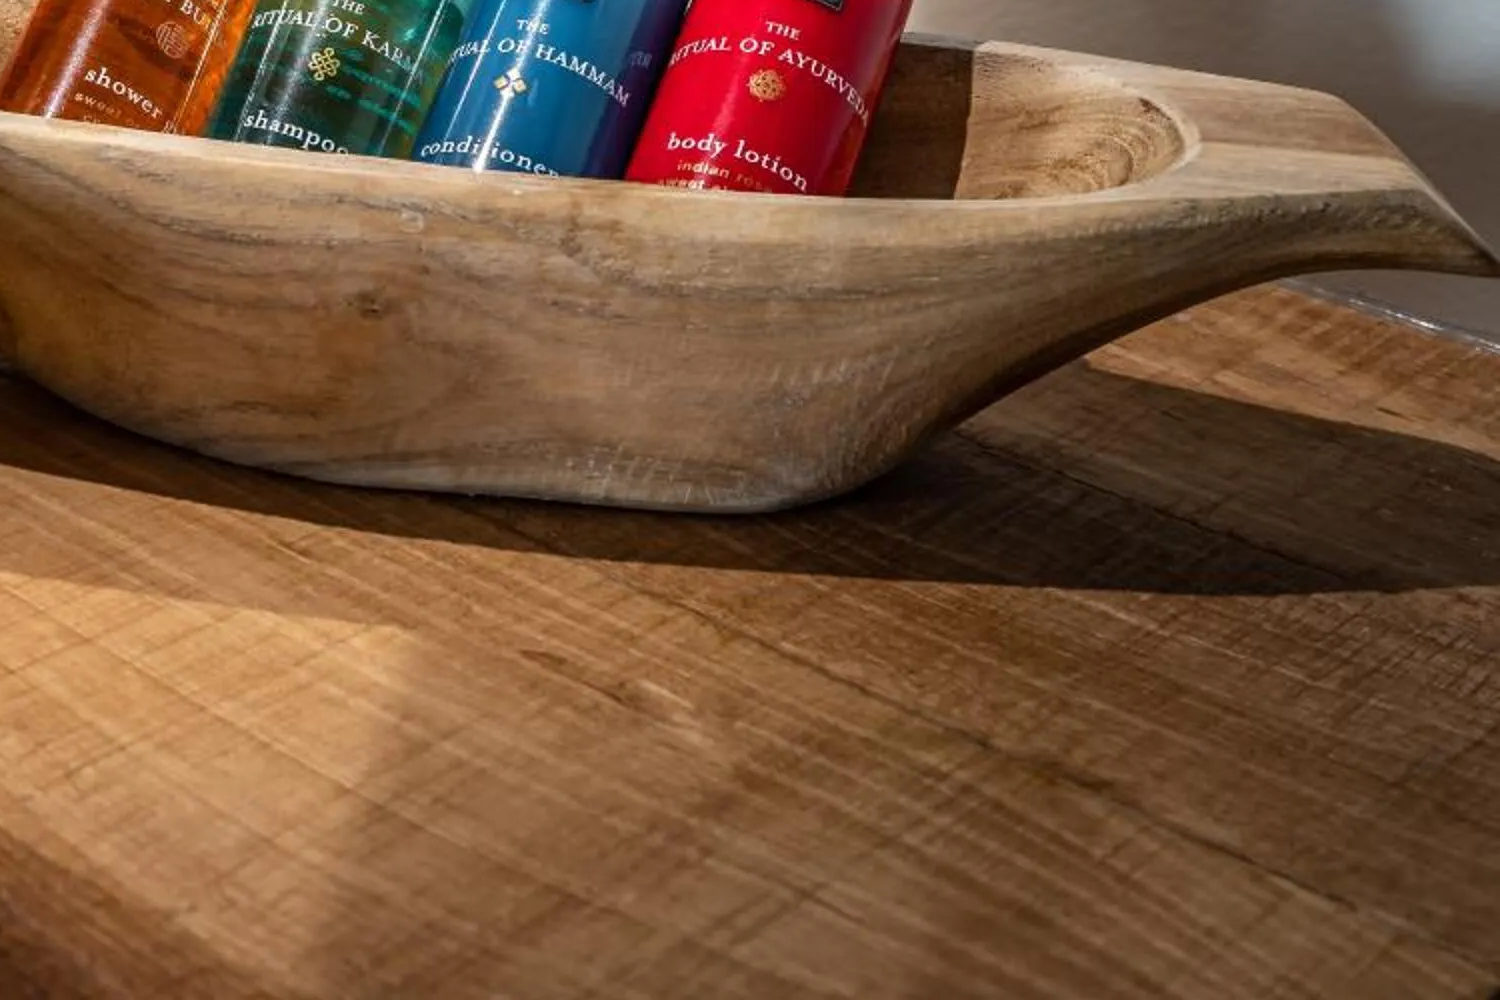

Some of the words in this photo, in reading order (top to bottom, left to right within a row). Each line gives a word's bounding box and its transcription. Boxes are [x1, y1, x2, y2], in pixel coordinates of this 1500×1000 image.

[325, 17, 359, 38] OF
[516, 19, 550, 35] THE
[764, 20, 802, 41] THE
[739, 37, 775, 56] OF
[535, 43, 630, 107] HAMMAM
[84, 67, 163, 119] shower
[667, 132, 728, 159] body
[734, 139, 808, 192] lotion
